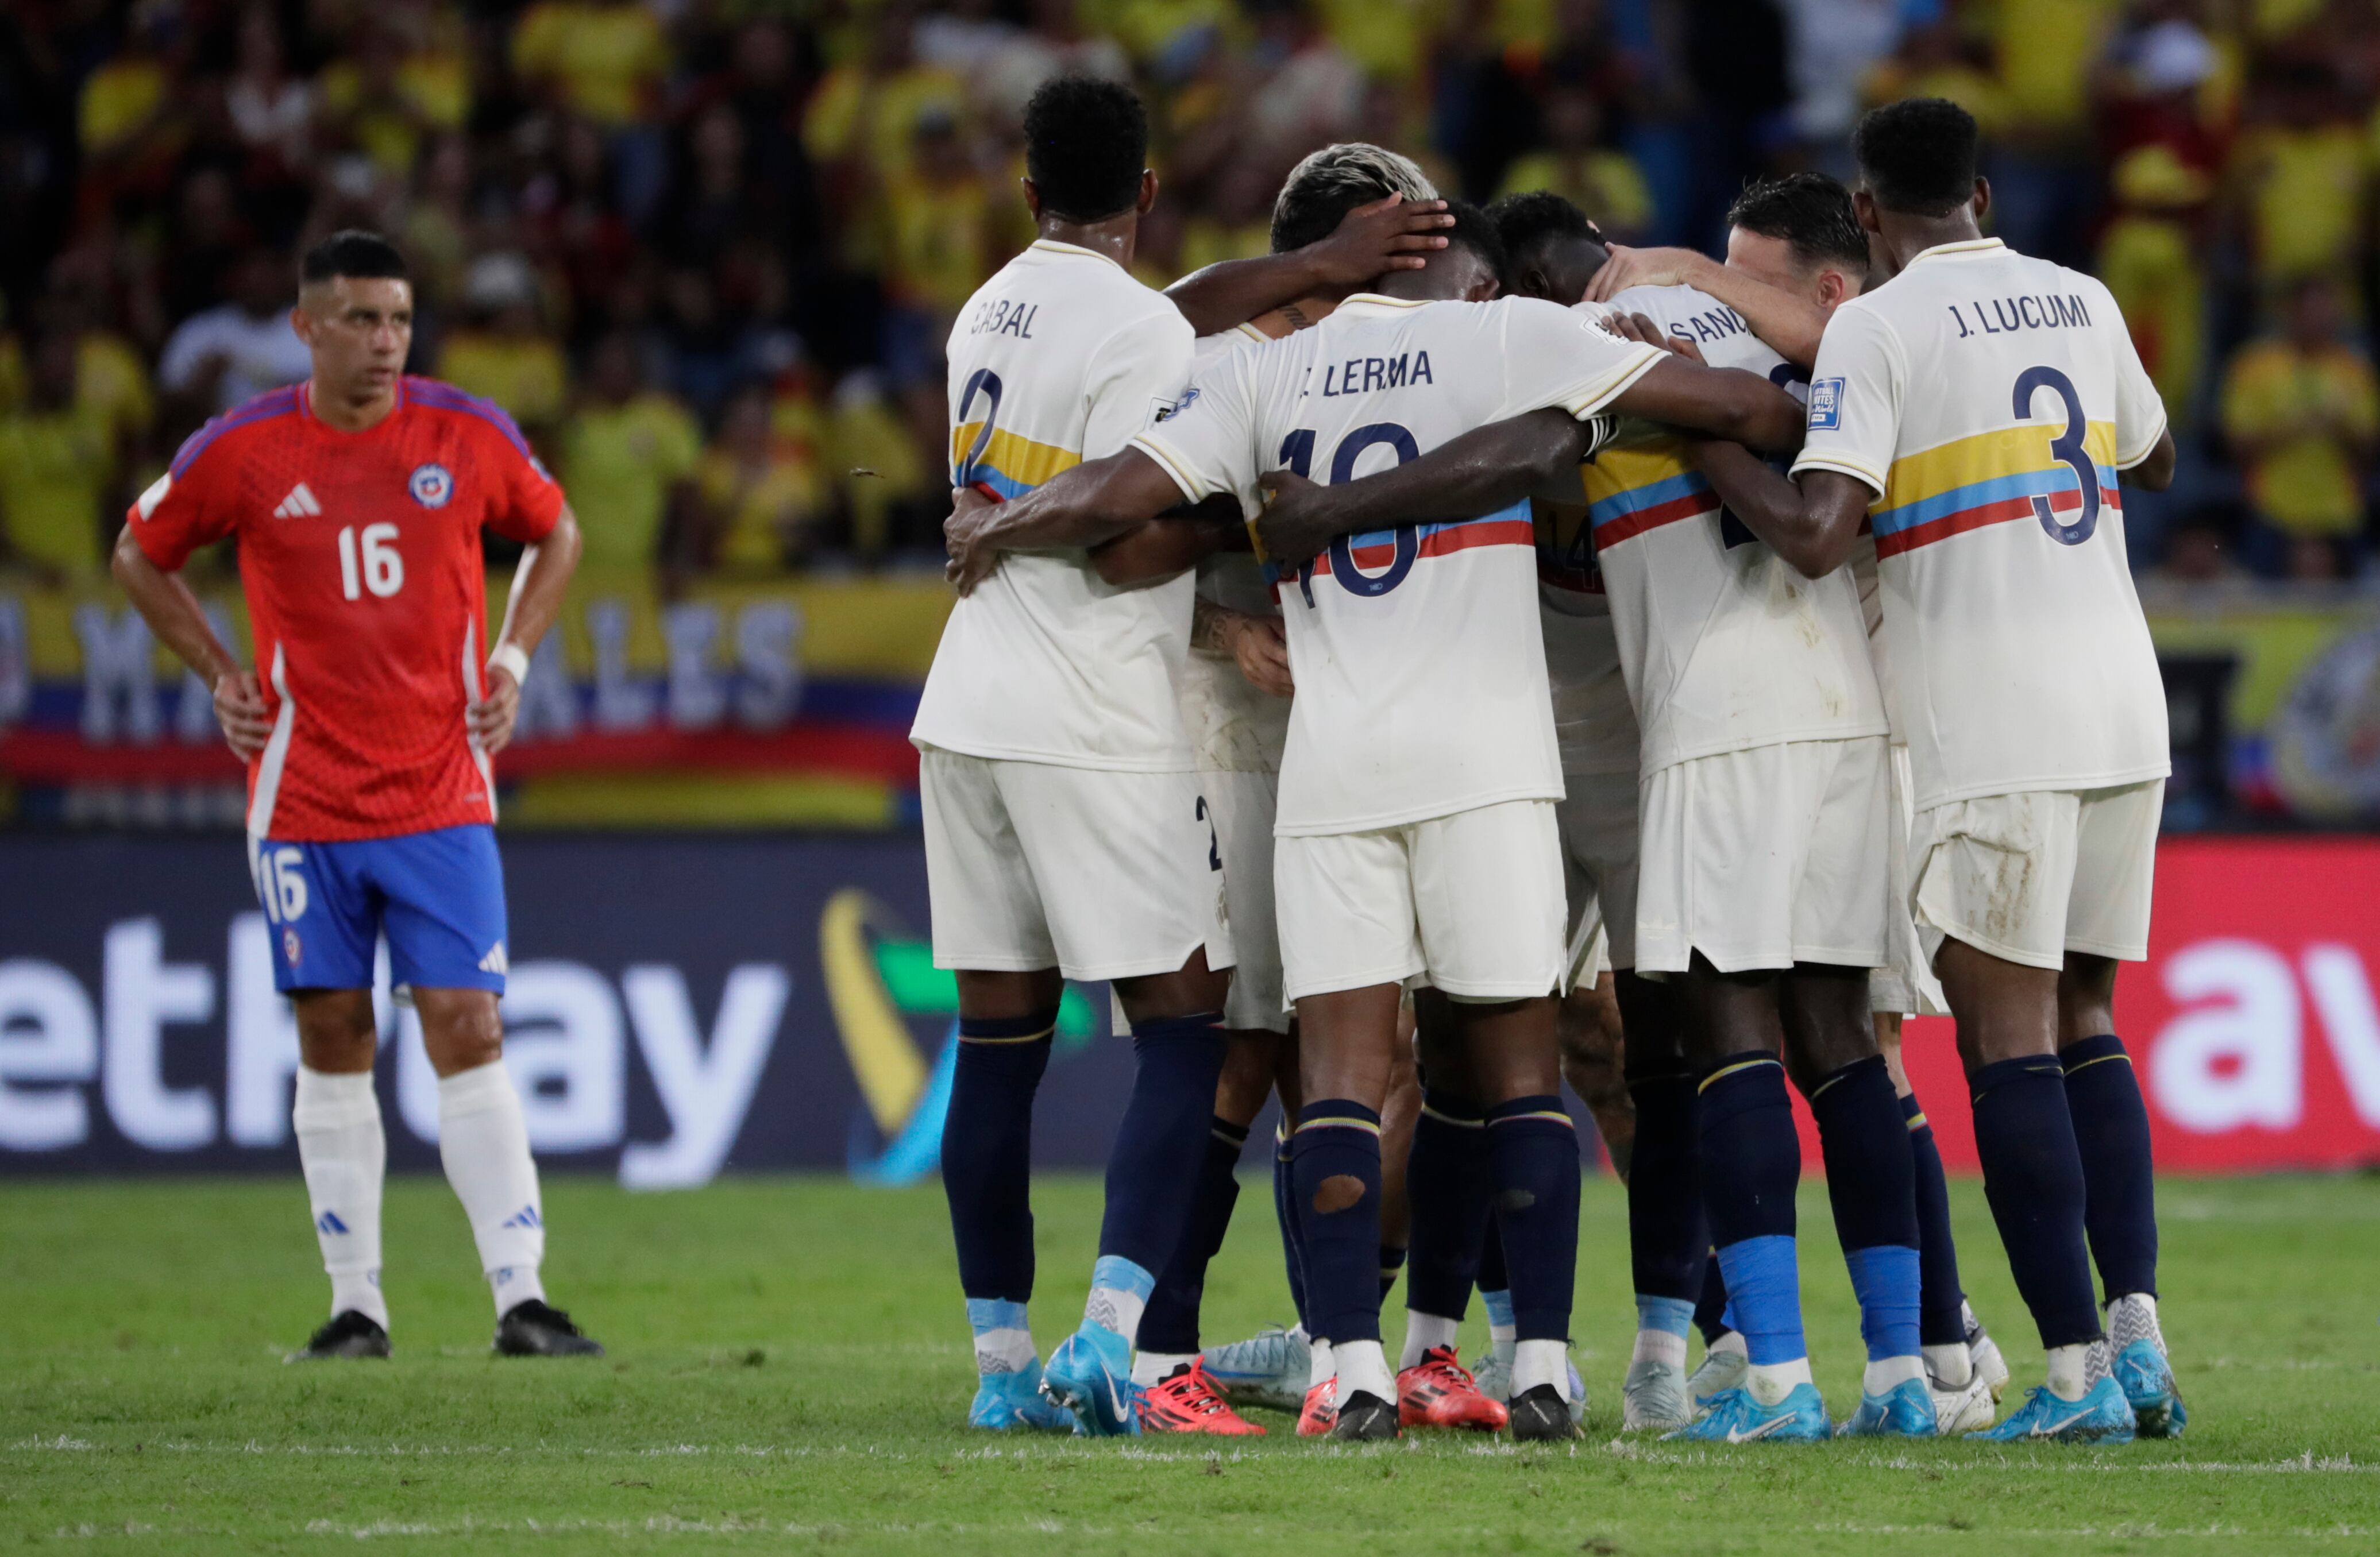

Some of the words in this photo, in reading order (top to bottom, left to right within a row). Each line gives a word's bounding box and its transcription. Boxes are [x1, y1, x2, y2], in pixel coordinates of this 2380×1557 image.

[1949, 305, 1974, 338] J.
[1974, 295, 2092, 334] LUCUMI
[1323, 350, 1433, 397] LERMA
[2012, 366, 2101, 546] 3
[338, 522, 404, 601] 16
[1195, 795, 1222, 872] 2
[259, 847, 308, 925] 16
